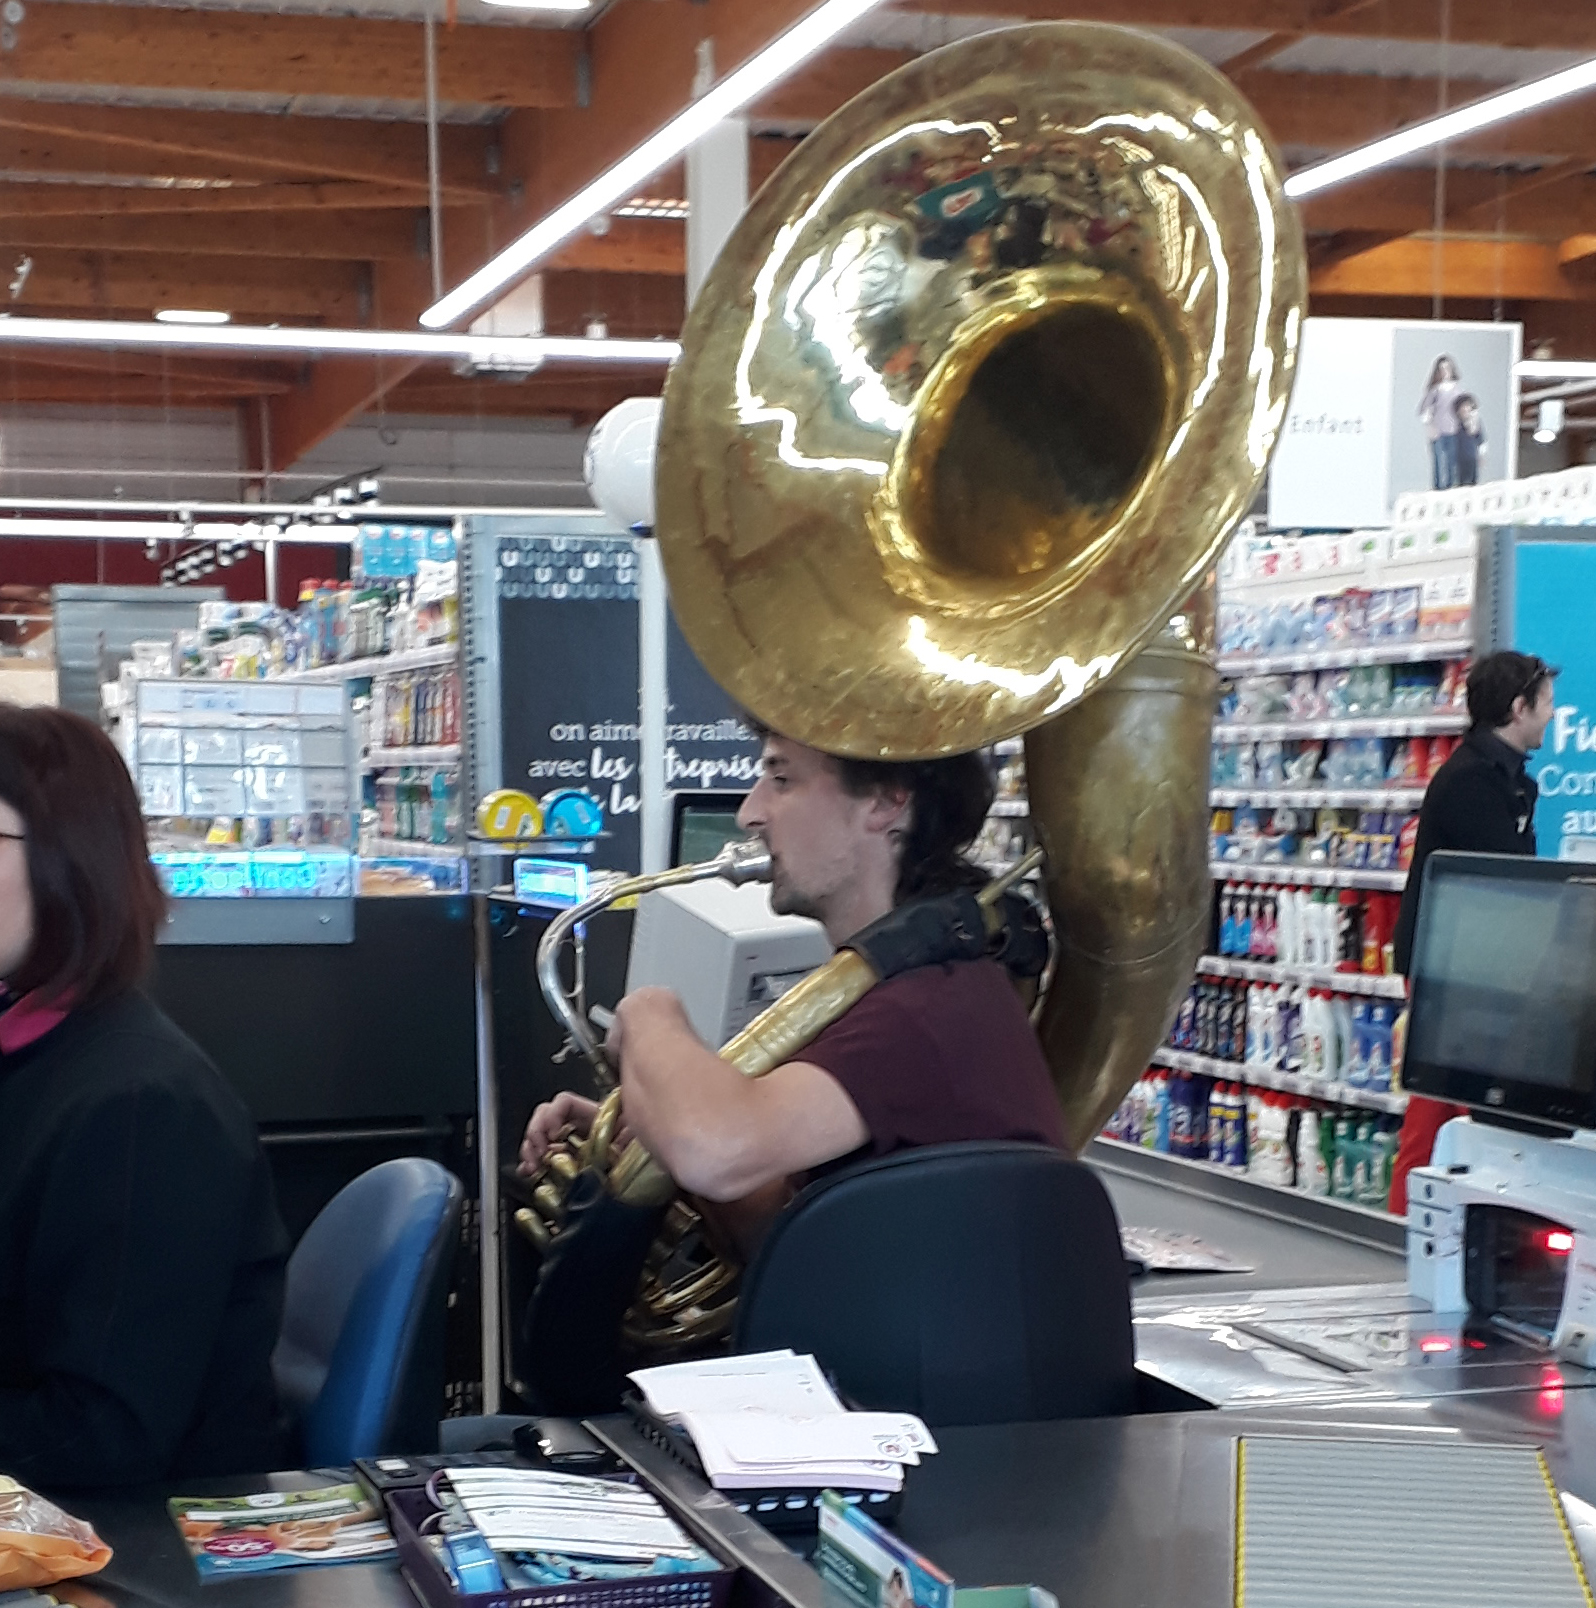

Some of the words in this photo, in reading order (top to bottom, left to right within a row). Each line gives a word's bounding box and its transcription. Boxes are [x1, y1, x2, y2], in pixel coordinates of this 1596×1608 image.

[1289, 412, 1365, 435] Enfant
[548, 722, 586, 742] on
[664, 718, 759, 742] ravaille
[1553, 704, 1596, 754] Fi
[527, 758, 587, 778] avec
[590, 745, 635, 781] les
